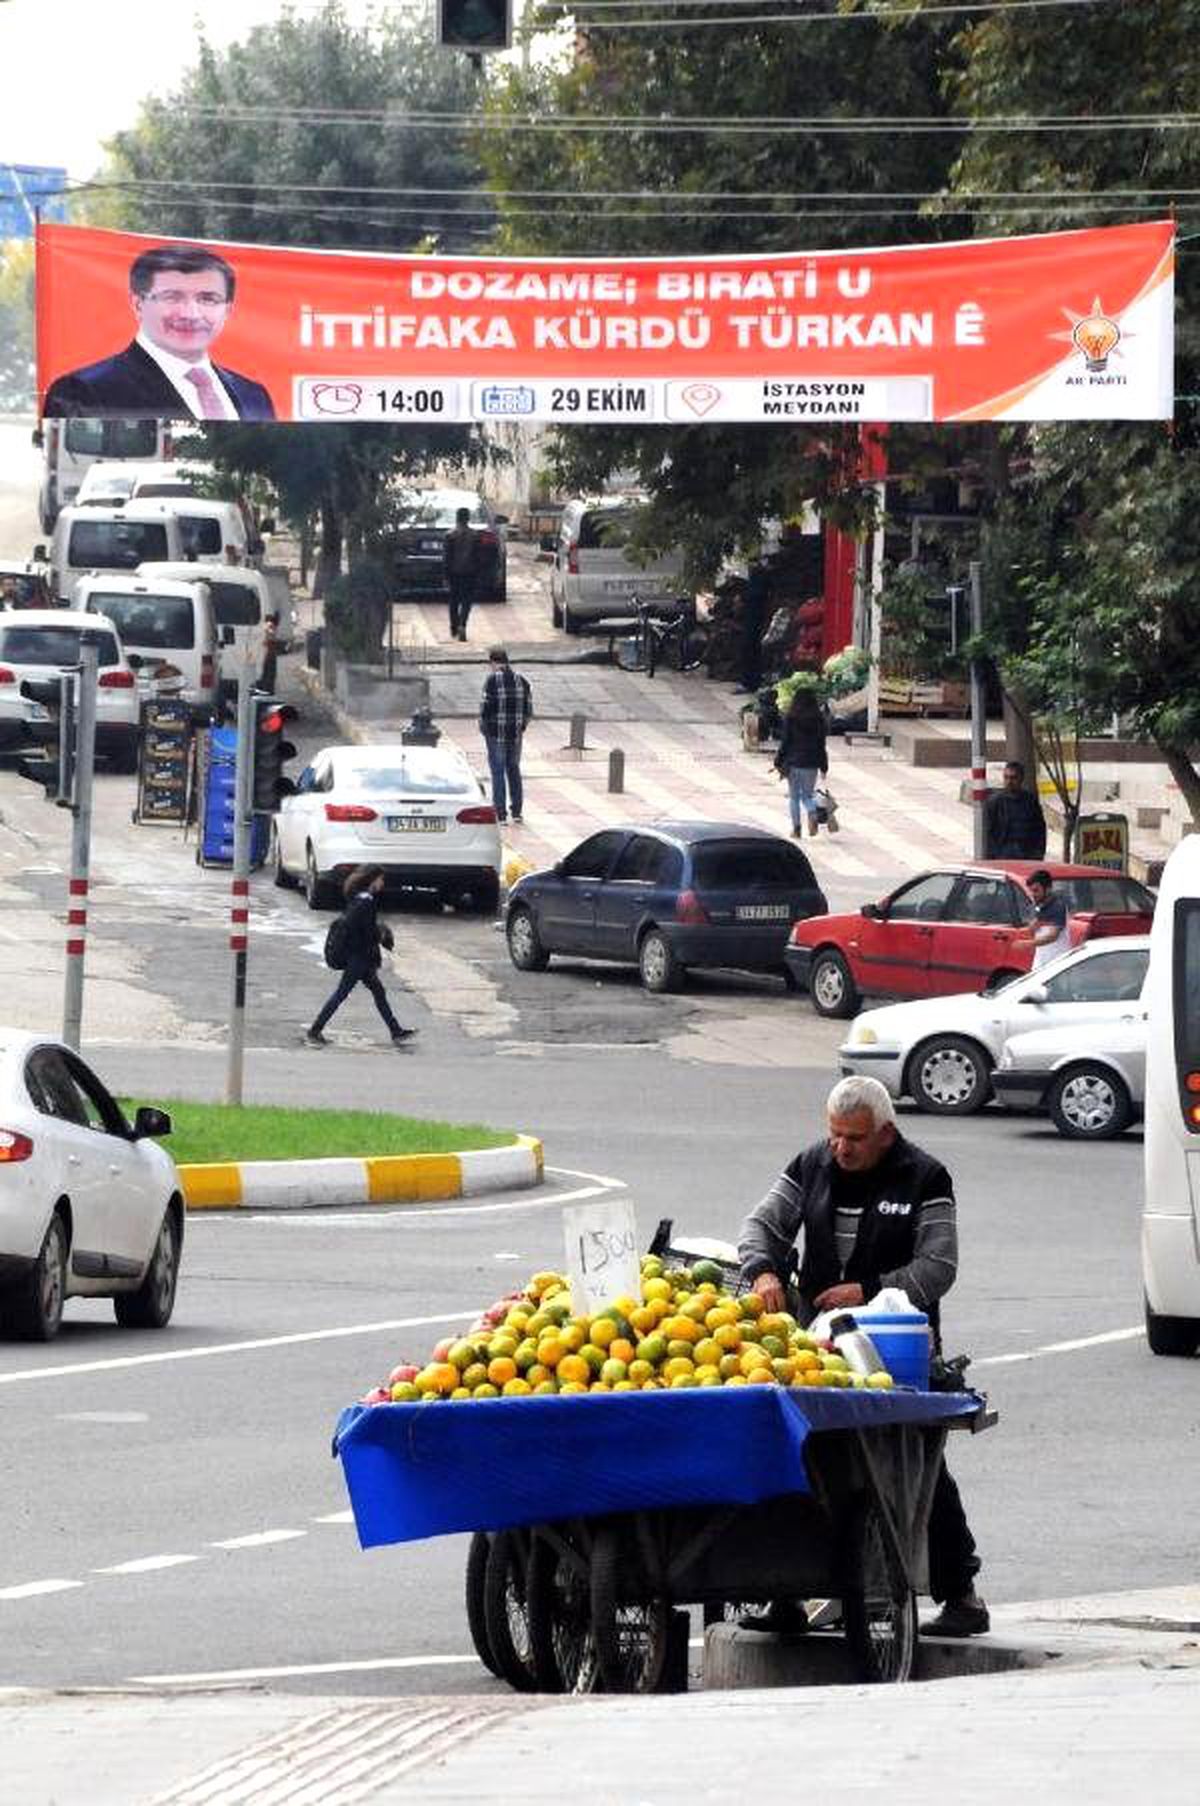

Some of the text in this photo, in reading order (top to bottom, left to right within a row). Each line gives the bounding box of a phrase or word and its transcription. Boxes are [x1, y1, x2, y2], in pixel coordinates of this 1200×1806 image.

[837, 267, 872, 297] U
[301, 302, 985, 349] İTTİFAKA KÜRDÜ TÜRKAN Ê
[376, 389, 444, 413] 14:00
[551, 383, 646, 411] 29 EKİM
[763, 381, 865, 396] İSTASYON
[763, 401, 859, 414] MEYDANI
